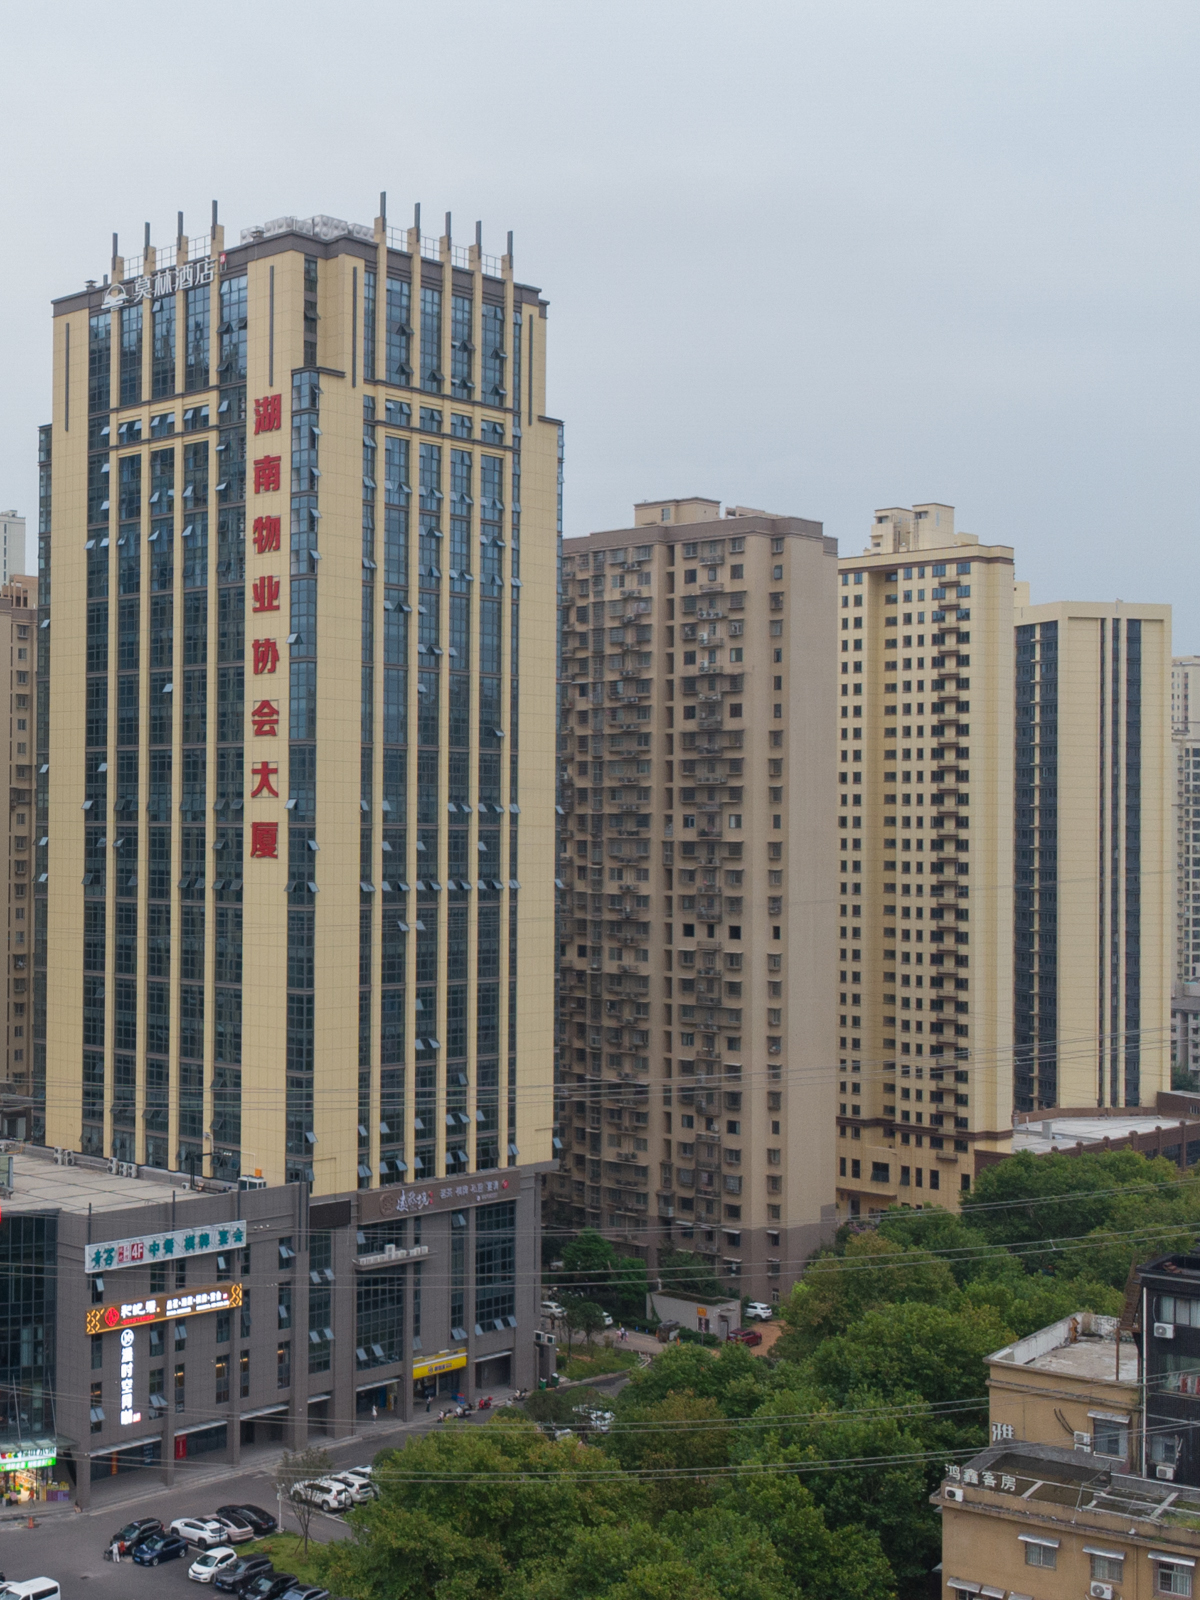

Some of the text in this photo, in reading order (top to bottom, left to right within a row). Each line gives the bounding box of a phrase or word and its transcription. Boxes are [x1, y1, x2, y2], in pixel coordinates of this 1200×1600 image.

[134, 258, 216, 302] 莫林酒店
[251, 394, 282, 859] 湖南物业协会大厦
[131, 1243, 143, 1260] 4F
[992, 1422, 1014, 1441] 雅
[944, 1463, 1016, 1492] 鸿鑫客房
